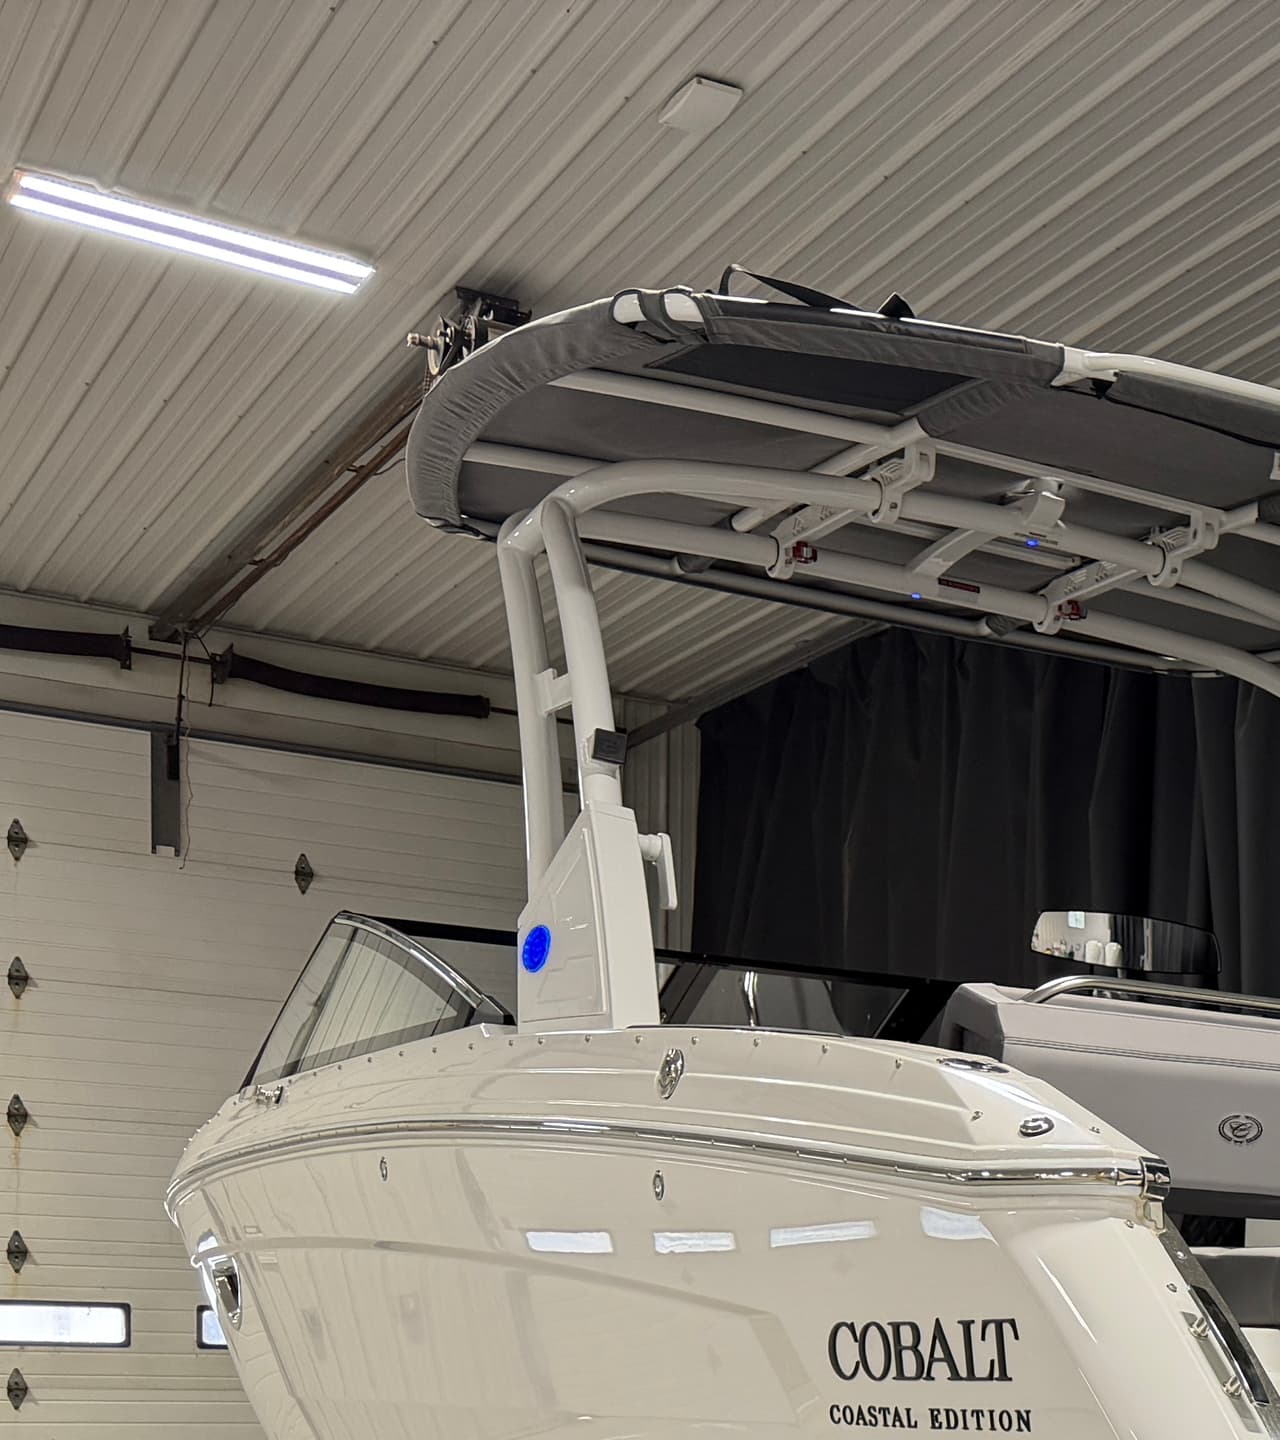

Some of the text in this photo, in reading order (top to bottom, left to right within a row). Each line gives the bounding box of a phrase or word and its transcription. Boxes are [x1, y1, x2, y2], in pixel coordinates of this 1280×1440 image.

[828, 1317, 1019, 1382] COBALT
[829, 1404, 1032, 1432] COASTAL EDITION
